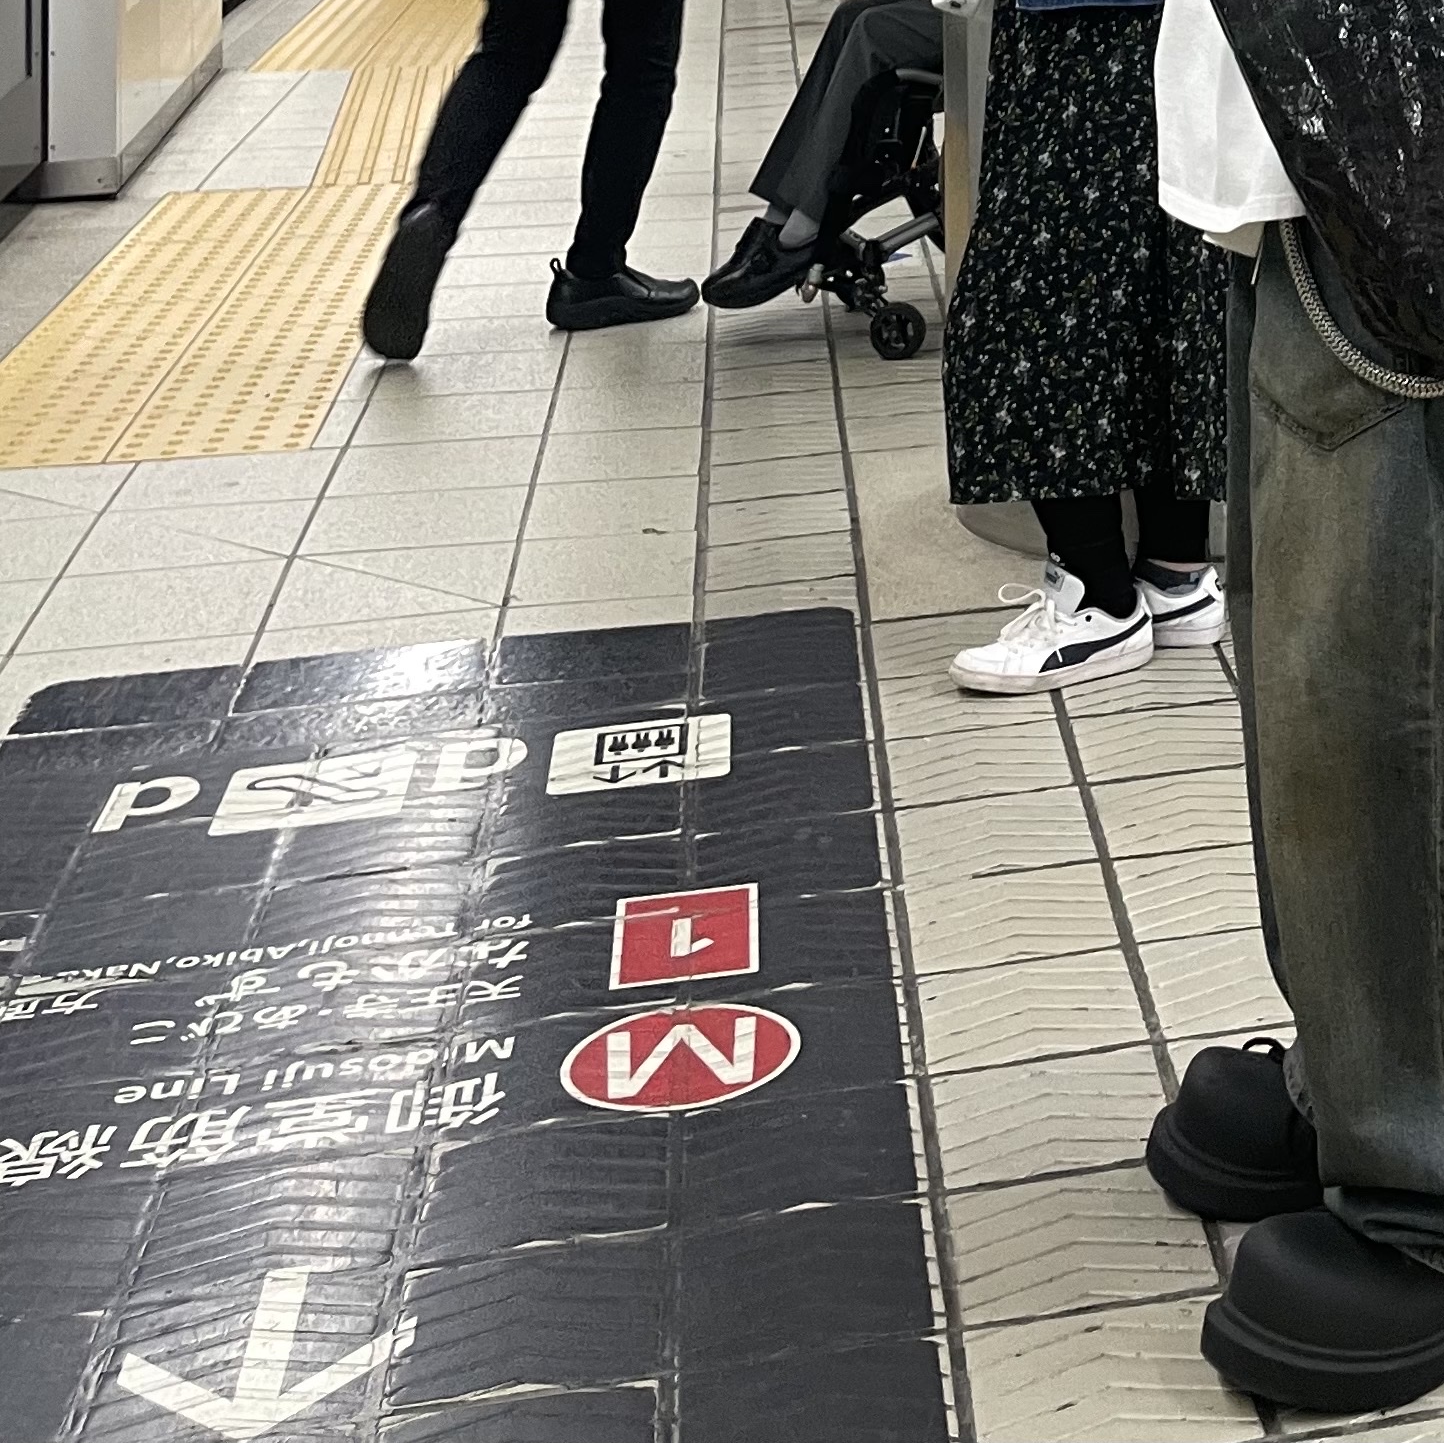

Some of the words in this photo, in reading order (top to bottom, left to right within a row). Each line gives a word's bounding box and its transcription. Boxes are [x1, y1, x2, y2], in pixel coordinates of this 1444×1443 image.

[113, 1067, 240, 1104] Line
[263, 1036, 517, 1093] Midosuji
[0, 1071, 507, 1186] 御堂筋線
